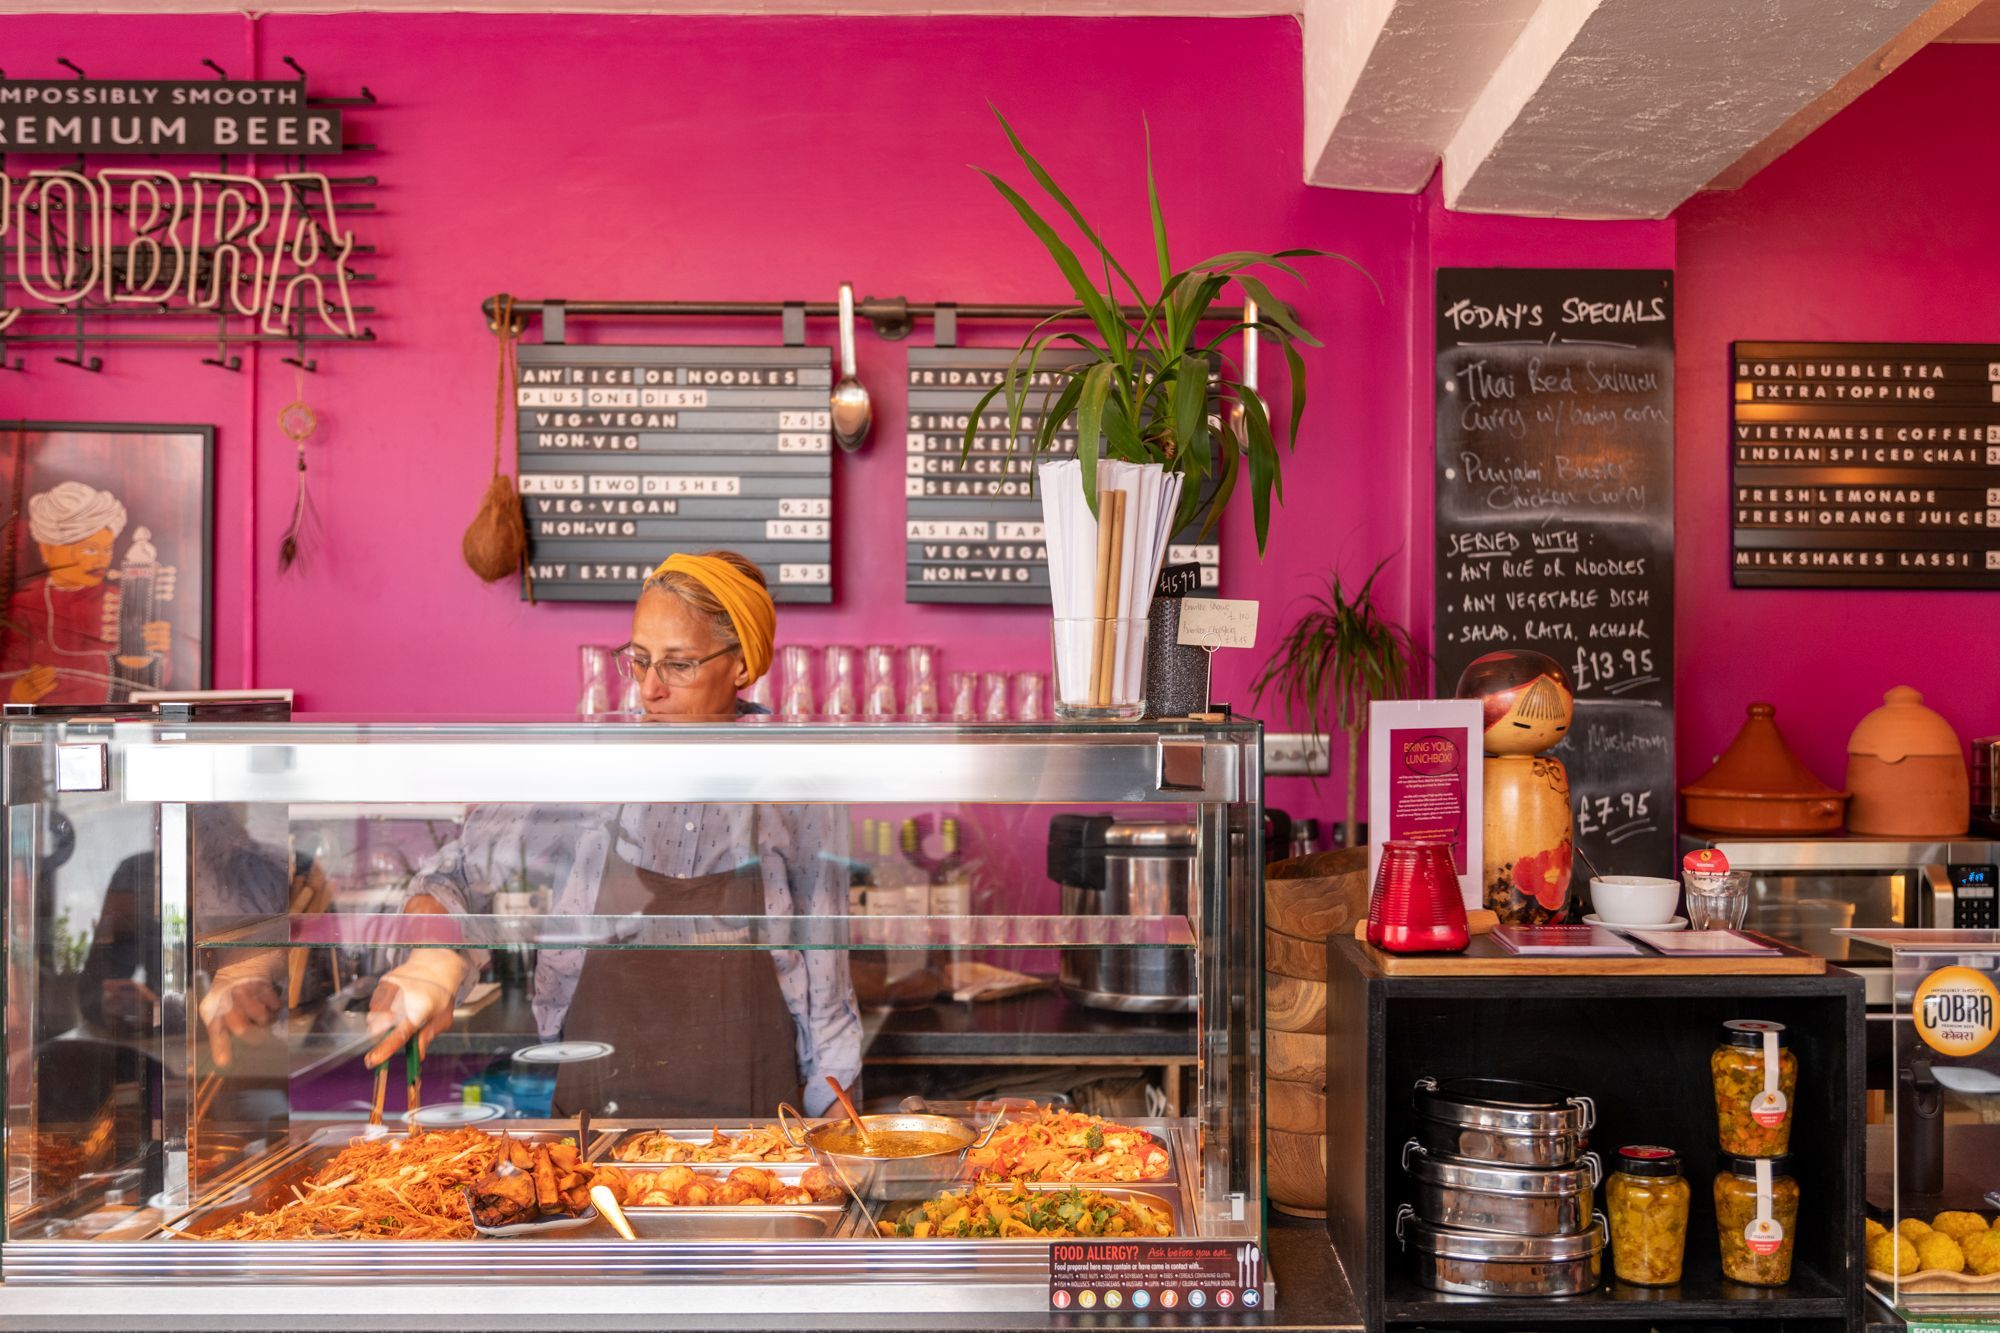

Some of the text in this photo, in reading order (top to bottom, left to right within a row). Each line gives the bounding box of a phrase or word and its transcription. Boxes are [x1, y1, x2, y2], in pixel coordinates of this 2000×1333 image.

[172, 88, 297, 105] SMOOTH
[214, 117, 333, 145] BEER
[0, 168, 357, 337] OBRA
[1445, 297, 1666, 331] TODAY'S SPECIALS
[523, 370, 795, 384] ANY RICE OR NOODLES
[911, 371, 1004, 384] FRIDAYS
[1739, 364, 1797, 377] BOBA
[1806, 364, 1891, 378] BUBBLE
[1903, 365, 1944, 378] TEA
[1456, 357, 1657, 401] Thai Red Salmon
[523, 393, 704, 405] PLUS ONE DISH
[1756, 385, 1936, 399] EXTRA TOPPING
[783, 415, 825, 426] 7.65
[1461, 400, 1527, 438] Curry
[1624, 405, 1669, 424] corn
[1738, 427, 1884, 440] VIETNAMESE
[1897, 428, 1983, 441] COFFEE
[781, 437, 822, 449] 8.95
[1740, 447, 1820, 461] INDIAN
[1829, 448, 1914, 462] SPICED
[1923, 449, 1977, 462] CHAI
[1460, 451, 1543, 490] Punjabi
[524, 480, 735, 491] PLUS TWO DISHES
[926, 481, 1031, 495] SEAFOOD
[1487, 483, 1646, 512] Chicken Curry
[1739, 489, 1810, 502] FRESH
[1819, 490, 1936, 503] LEMONADE
[781, 503, 824, 514] 9.25
[1739, 510, 1809, 523] FRESH
[1819, 511, 1906, 524] ORANGE
[1918, 511, 1983, 525] JUICE
[773, 525, 824, 536] 10.45
[911, 525, 984, 536] ASIAN
[1446, 531, 1520, 557] SERVED
[925, 546, 1213, 560] VEG+VEGA 6.45
[1737, 552, 1884, 566] MILKSHAKES
[1900, 553, 1969, 566] LASSI
[783, 568, 824, 579] 3.95
[1460, 558, 1646, 582] ANY RICE OR NOODLES
[1160, 570, 1196, 593] £15.99
[1463, 587, 1650, 613] ANY VEGETABLE DISH
[1589, 618, 1650, 639] ACHAAR
[1572, 646, 1654, 690] £13.95
[1404, 741, 1454, 752] BRING YOUR
[1577, 790, 1652, 836] £7.95
[1923, 994, 1992, 1031] COBRA
[1054, 1245, 1139, 1260] FOOD ALLERGY?
[1148, 1247, 1166, 1257] Ask
[1167, 1247, 1194, 1257] before
[1195, 1249, 1211, 1260] you
[1054, 1262, 1067, 1270] Food
[1067, 1262, 1089, 1272] prepared
[1090, 1262, 1101, 1270] here
[1101, 1264, 1113, 1272] may
[1138, 1262, 1150, 1270] have
[1165, 1262, 1170, 1270] in
[1170, 1262, 1188, 1270] contact
